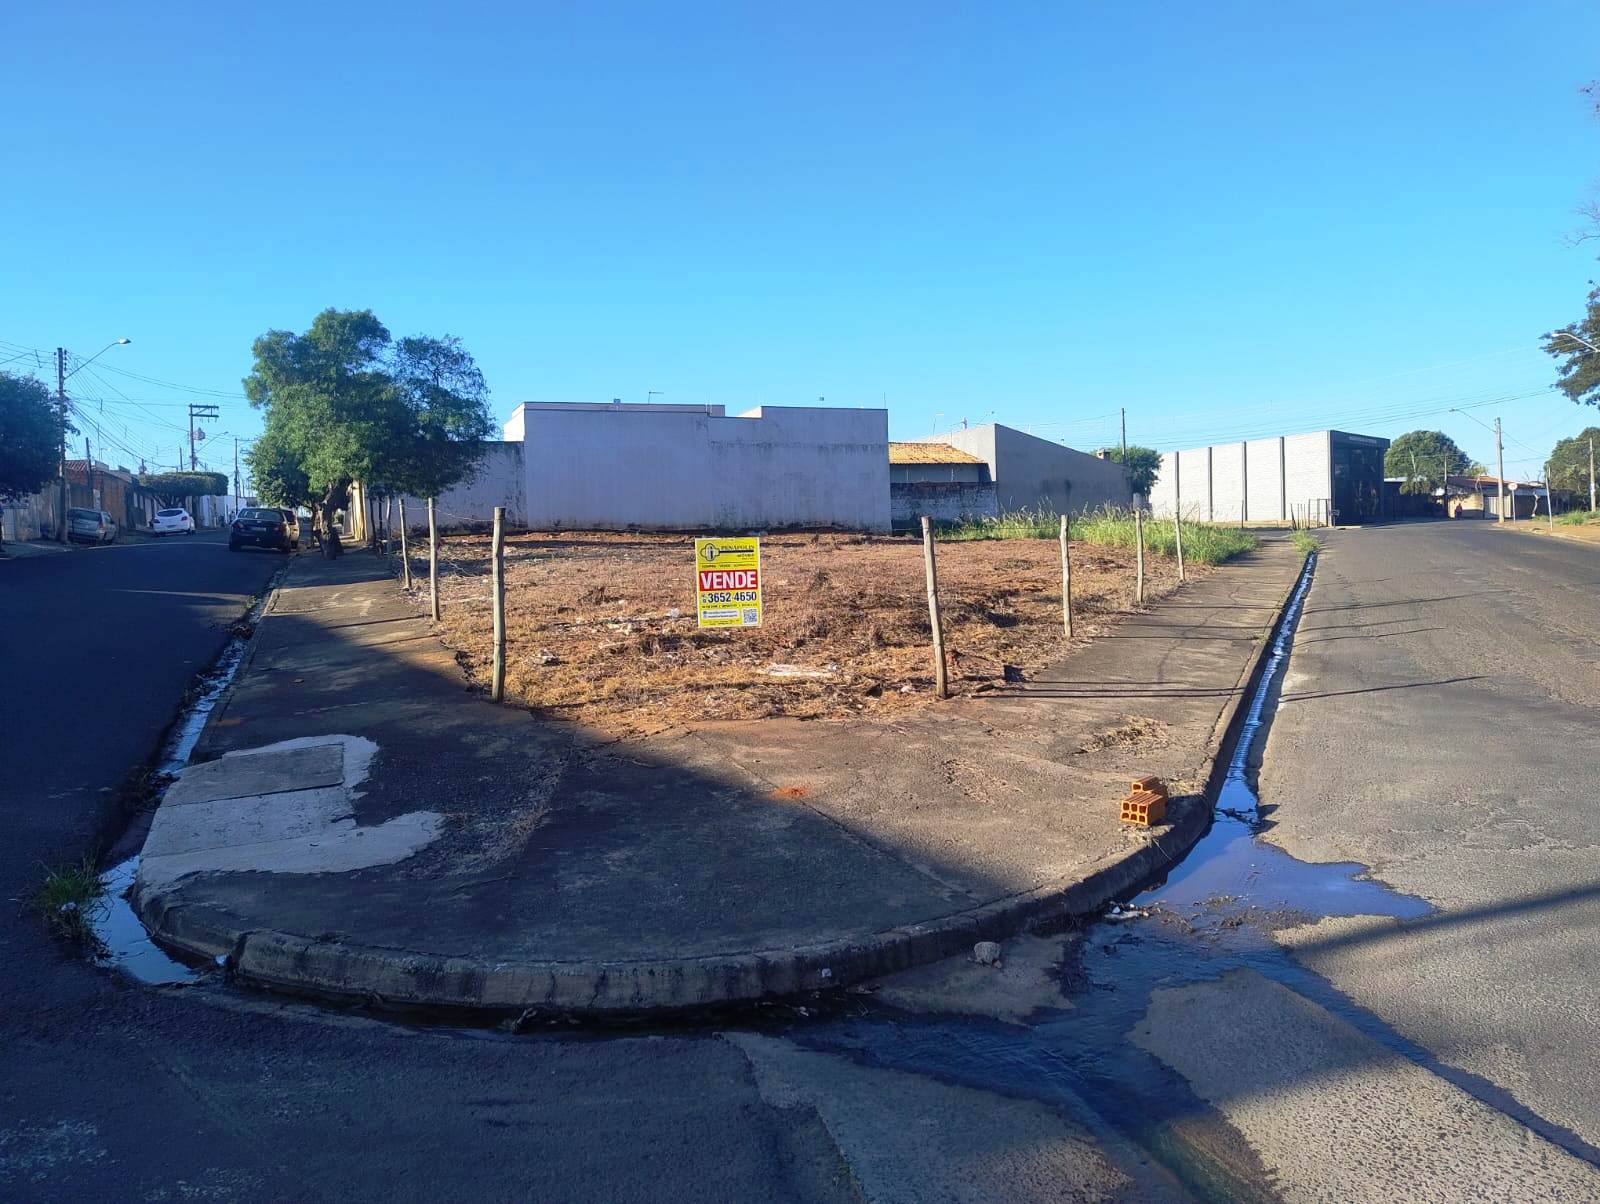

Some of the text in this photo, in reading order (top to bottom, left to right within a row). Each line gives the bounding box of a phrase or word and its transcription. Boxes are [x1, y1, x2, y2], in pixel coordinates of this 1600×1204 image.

[700, 571, 757, 590] VENDE
[708, 592, 731, 603] 3652
[733, 591, 757, 602] 4650
